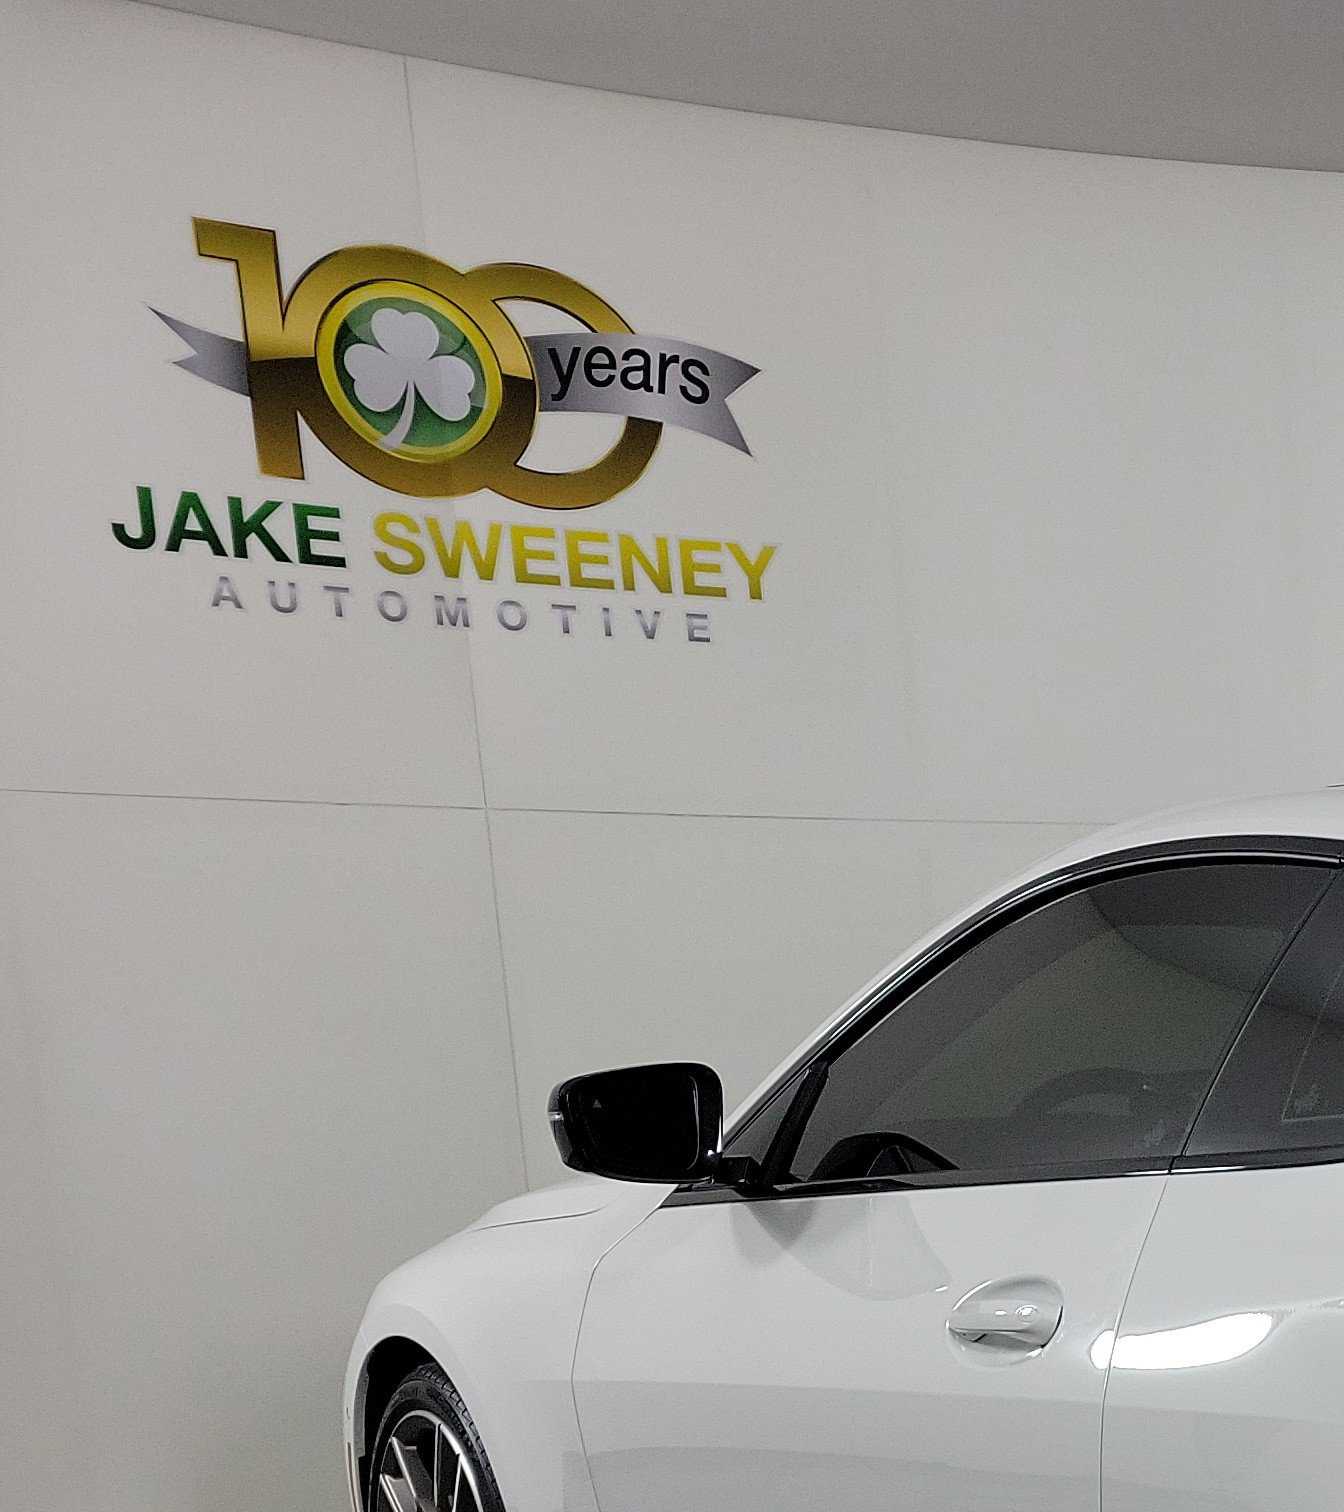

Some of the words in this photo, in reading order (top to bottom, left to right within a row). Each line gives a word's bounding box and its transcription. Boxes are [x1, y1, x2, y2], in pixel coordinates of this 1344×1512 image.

[191, 216, 663, 510] 100
[547, 342, 711, 404] years
[110, 485, 347, 568] JAKE
[371, 511, 779, 601] SWEENEY
[210, 576, 712, 643] AUTOMOTIVE
